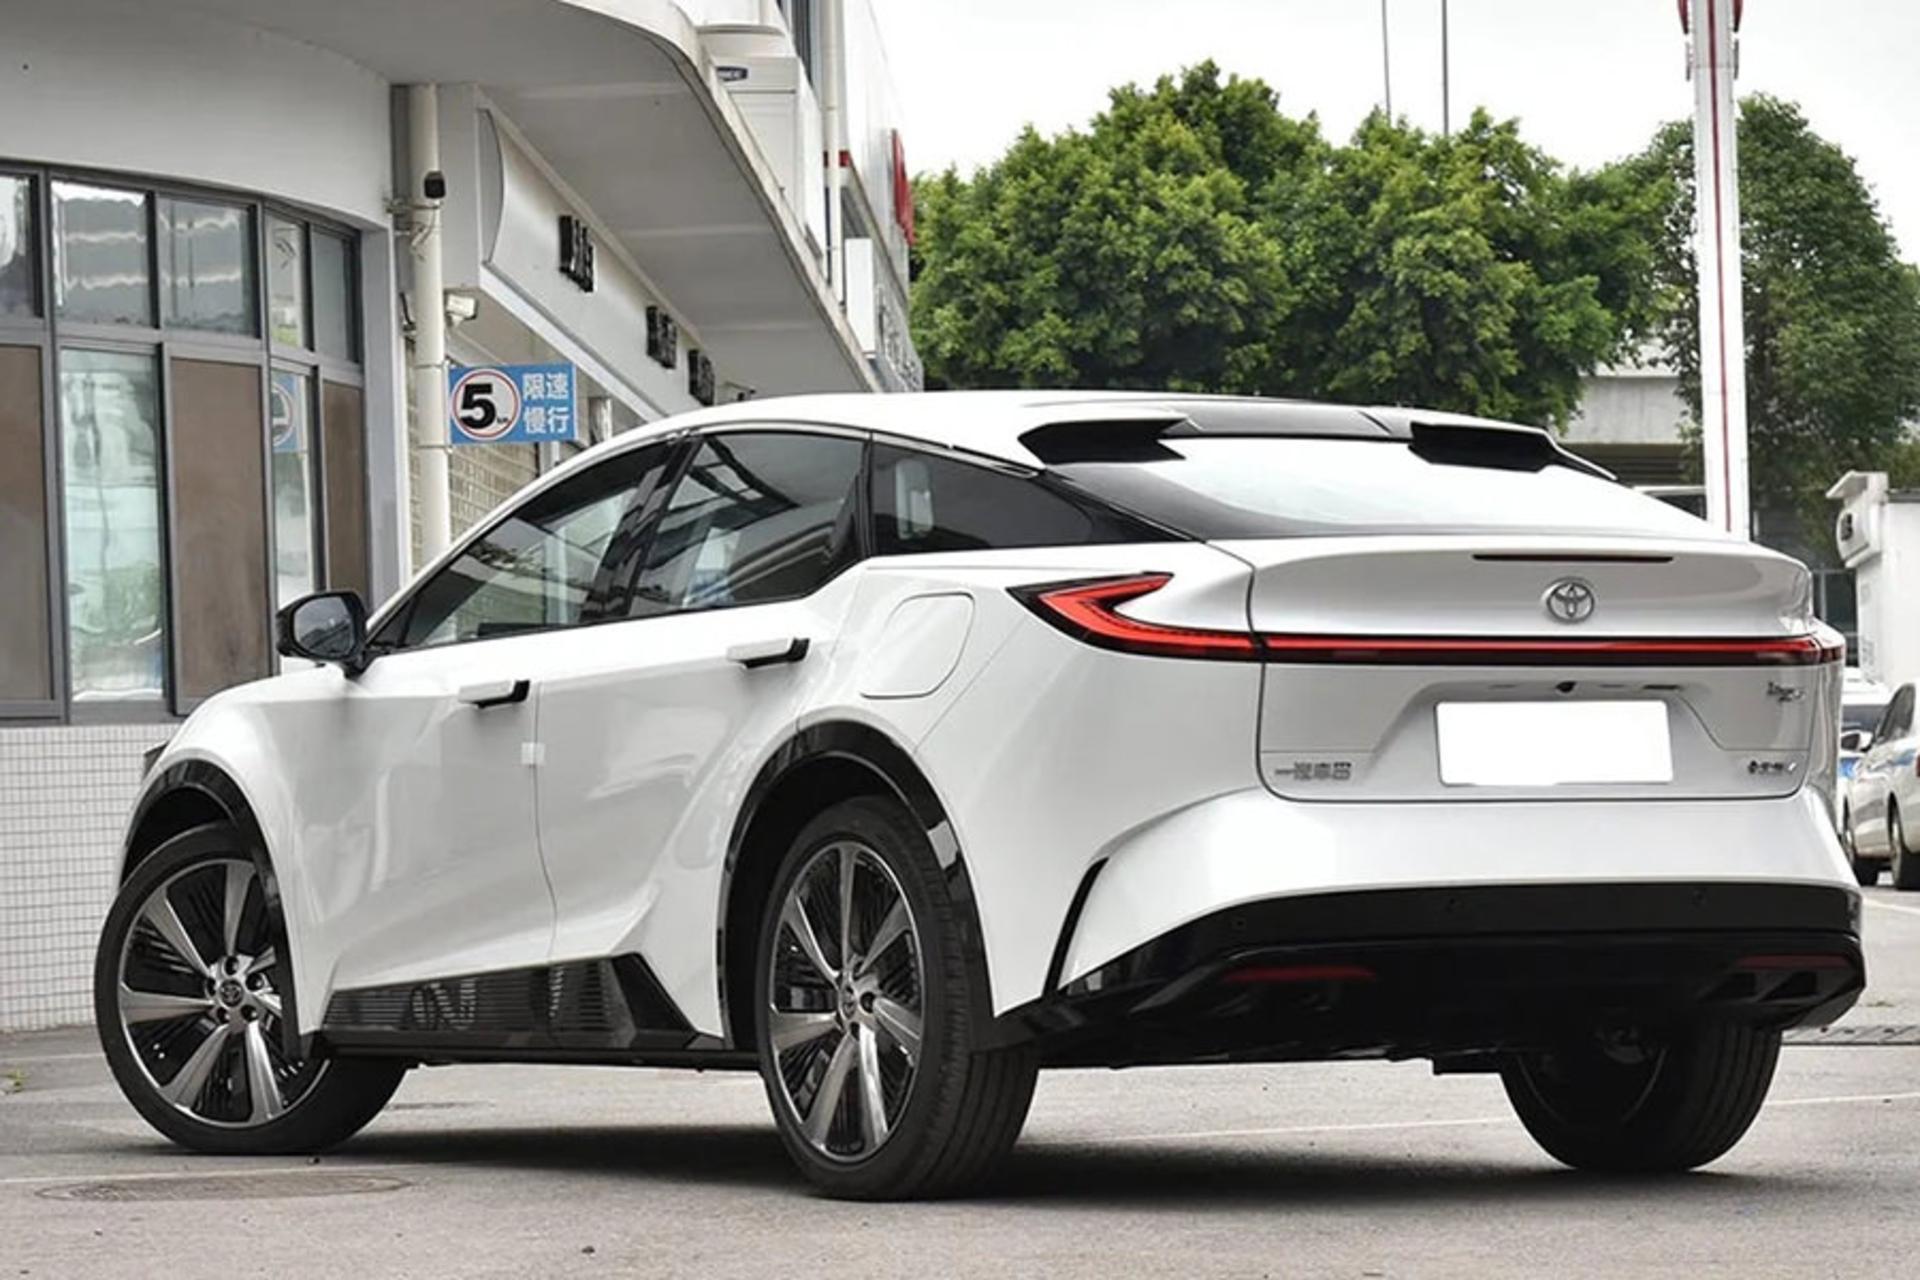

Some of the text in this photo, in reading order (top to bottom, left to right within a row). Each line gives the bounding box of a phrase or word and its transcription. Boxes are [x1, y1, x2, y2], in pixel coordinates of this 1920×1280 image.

[522, 372, 569, 400] 限速
[460, 383, 496, 429] 5
[523, 406, 570, 434] 慢行
